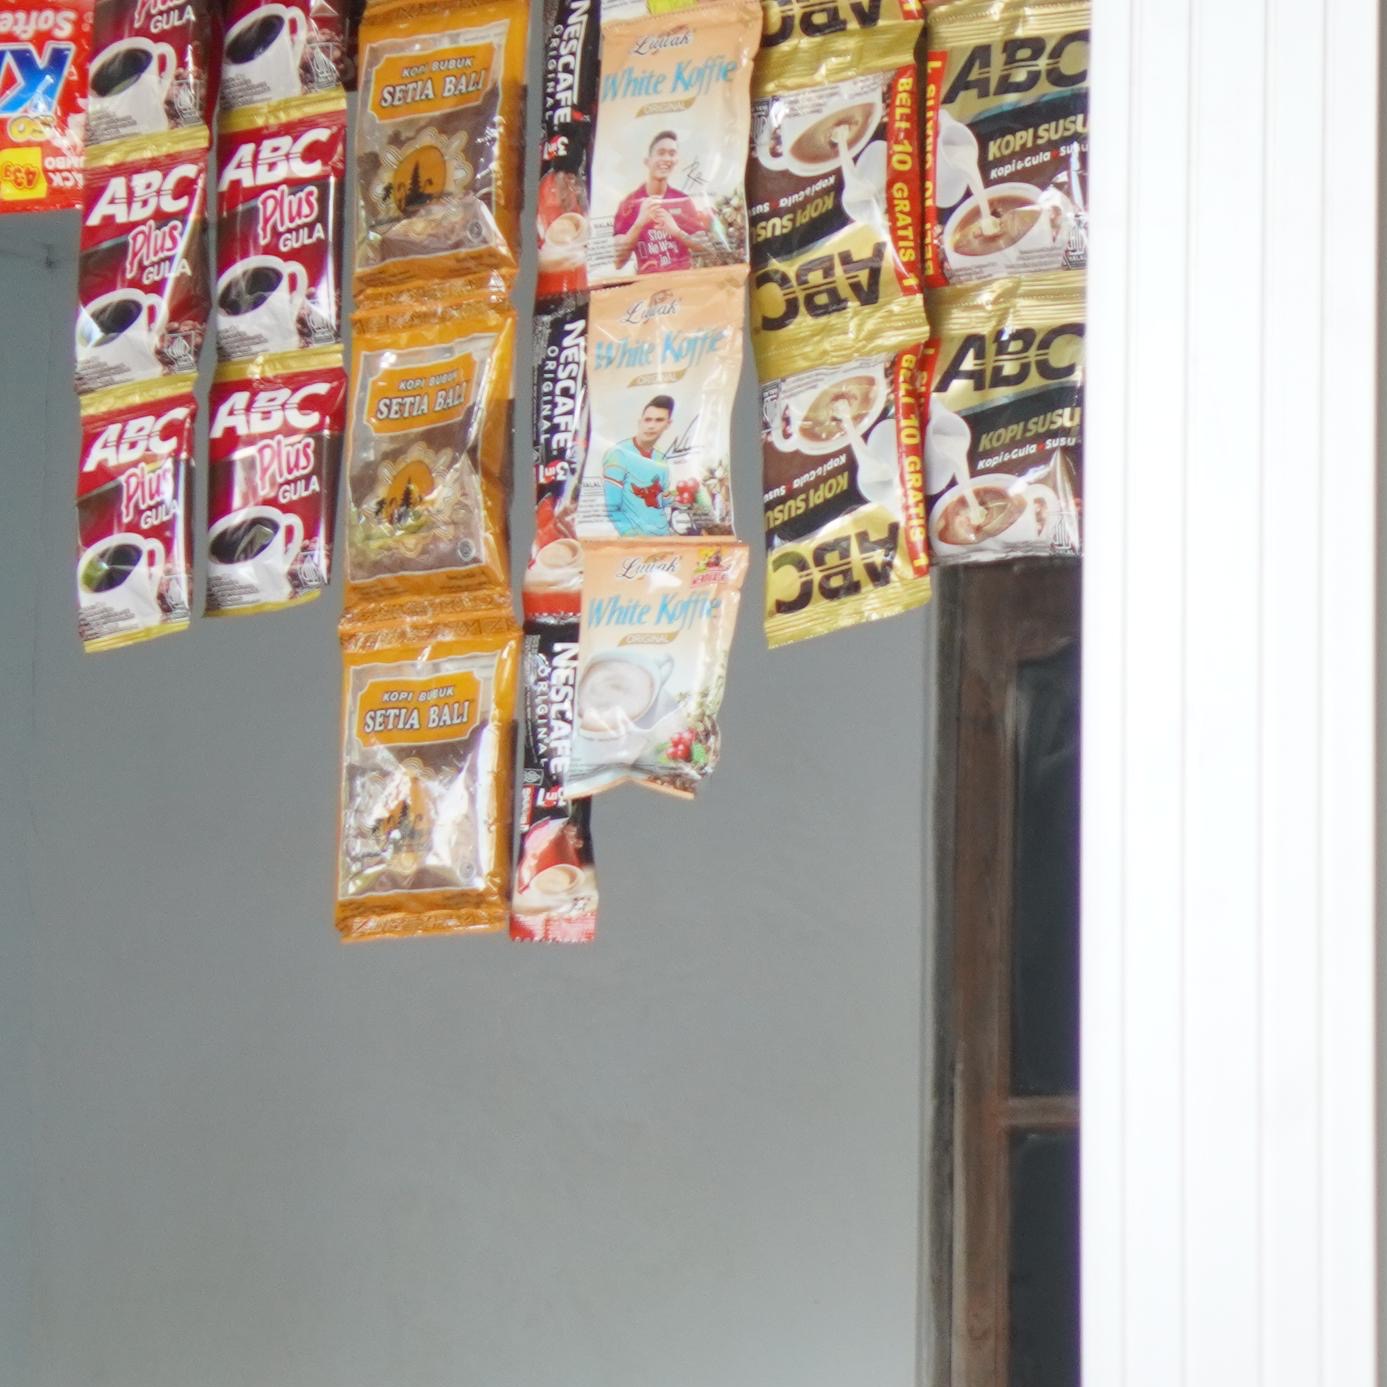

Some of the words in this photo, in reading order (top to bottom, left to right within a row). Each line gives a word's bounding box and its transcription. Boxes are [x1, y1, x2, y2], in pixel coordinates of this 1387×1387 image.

[151, 5, 195, 33] GULA
[381, 78, 434, 107] SETIA
[443, 69, 487, 97] BALI
[545, 24, 564, 120] ORIGINAL
[602, 67, 667, 103] White
[671, 56, 738, 97] Koffie
[941, 29, 1090, 105] ABC
[895, 77, 914, 129] BELI
[218, 127, 332, 192] ABC
[892, 139, 914, 171] 10
[988, 128, 1033, 161] KOPI
[85, 163, 199, 226] ABC
[258, 184, 318, 246] Plus
[796, 192, 835, 226] KOPI
[279, 223, 325, 252] GULA
[892, 182, 916, 263] GRATIS
[125, 219, 182, 279] Plus
[142, 258, 192, 284] GULA
[756, 241, 886, 331] ABC
[902, 273, 920, 288] 1
[932, 323, 1085, 393] ABC
[377, 393, 429, 420] SETIA
[399, 379, 424, 391] KOPI
[539, 345, 559, 443] ORIGINAL
[210, 383, 332, 438] ABC
[901, 414, 919, 444] 10
[978, 422, 1024, 453] KOPI
[1025, 406, 1081, 438] SUSU
[82, 407, 191, 472] ABC
[1045, 436, 1076, 450] Susu
[255, 434, 314, 496] Plus
[121, 458, 174, 523] Plus
[278, 475, 320, 503] GULA
[808, 471, 849, 507] KOPI
[906, 455, 926, 542] GRATIS
[616, 556, 680, 581] Luwak
[772, 521, 901, 615] ABC
[912, 552, 929, 567] 1
[587, 596, 652, 629] White
[364, 707, 420, 733] SETIA
[428, 701, 472, 728] BALI
[382, 691, 413, 702] KOPI
[536, 664, 552, 770] ORIGINAL
